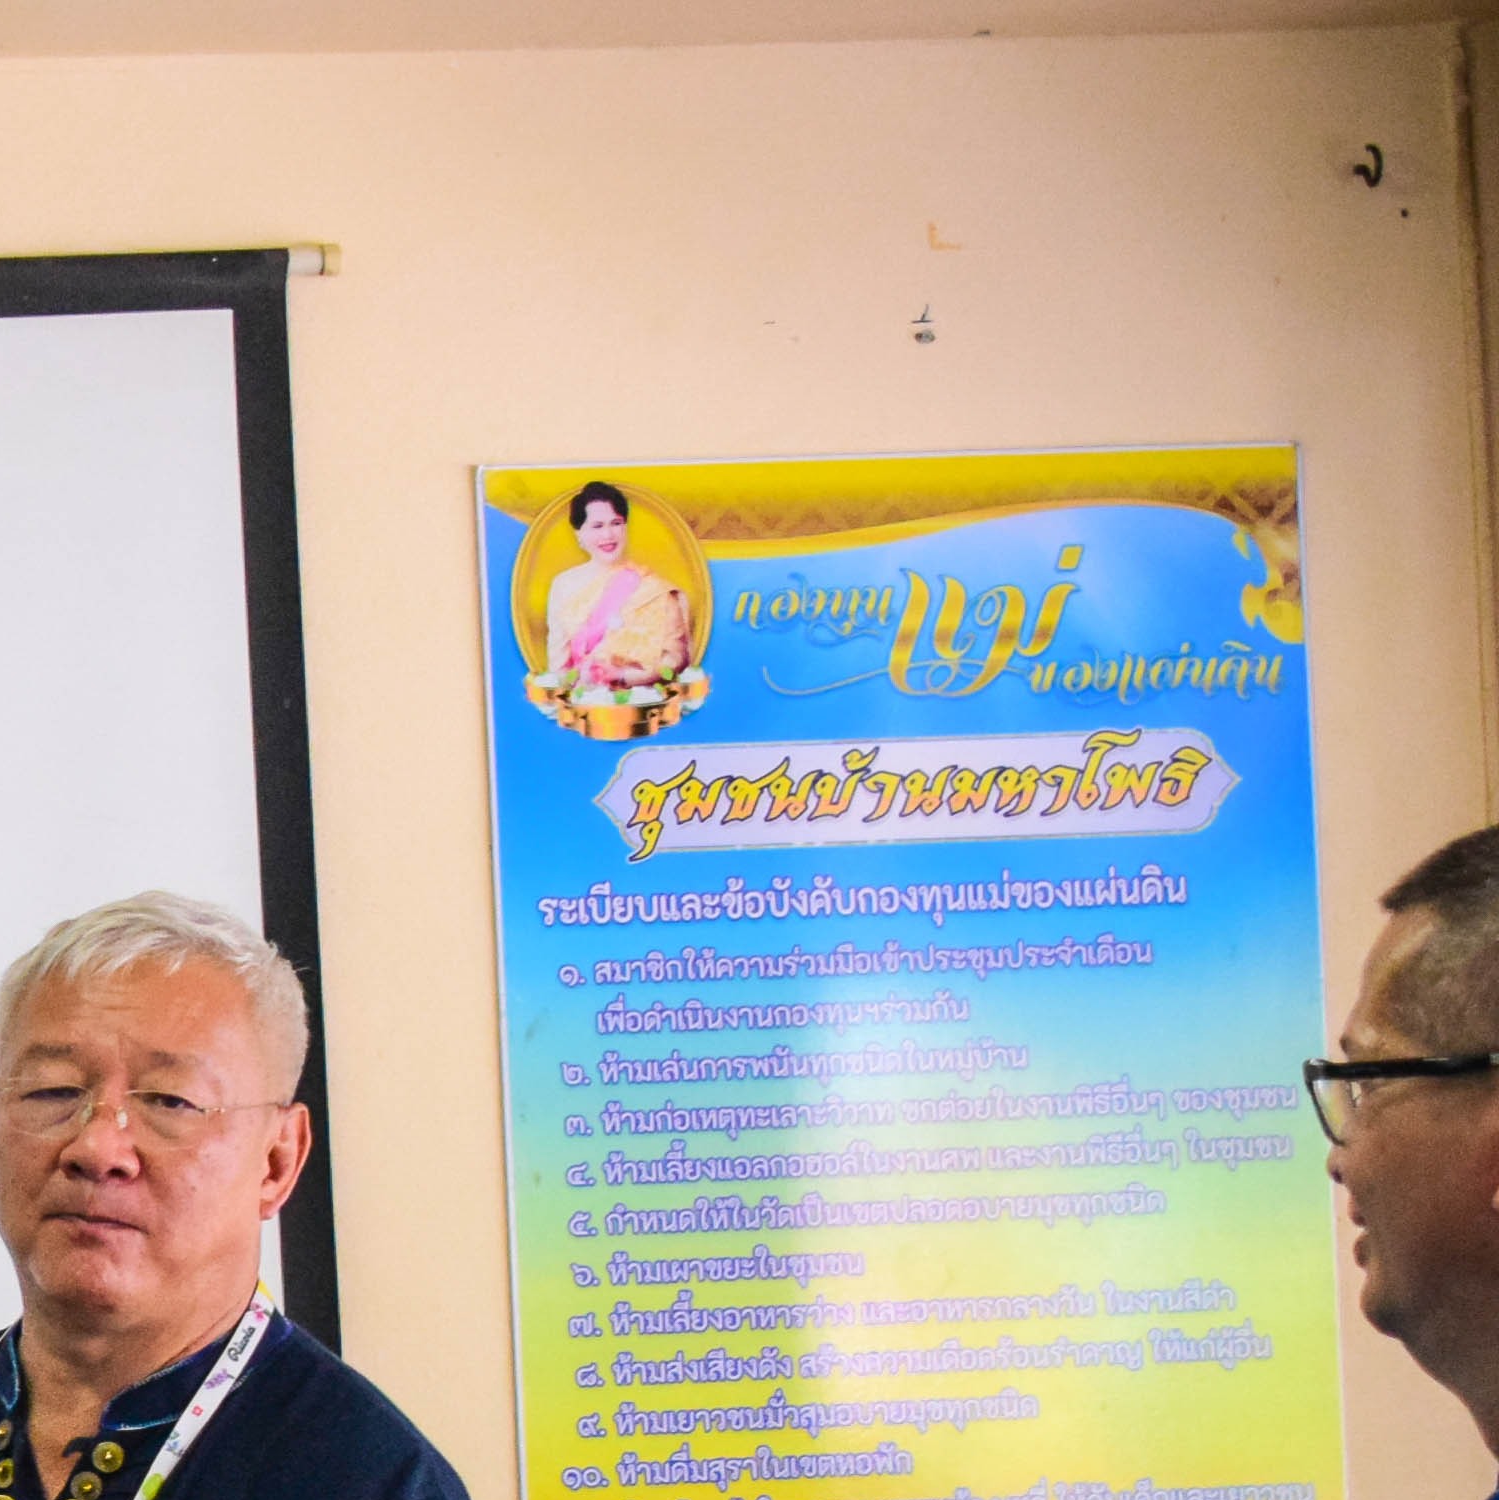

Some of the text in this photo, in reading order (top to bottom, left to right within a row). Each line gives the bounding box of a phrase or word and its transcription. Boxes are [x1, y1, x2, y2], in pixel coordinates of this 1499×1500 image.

[885, 544, 1085, 697] แม่
[628, 725, 1213, 862] ชุมชนบ้านมหาโพธิ
[537, 863, 1187, 927] ระเบียบและข้อบังคับกองทุนแม่ของแผ่นดิน
[559, 932, 1152, 986] ๑. สมาชิกให้ความร่วมมือเข้าประชุมประจำเดือน
[597, 990, 969, 1036] เพื่อดำเนินงานกองทุนฯร่วมกัน
[599, 1036, 1028, 1085] ห้ามเล่นการพนันทุกชนิดในหมู่บ้าน
[601, 1095, 893, 1140] ห้ามก่อเหตุทะเลาะวิวาท
[1173, 1086, 1298, 1123] ของชุมชน
[603, 1139, 980, 1184] ห้ามเลี้ยงแอลกอฮอล์ในงานศพ
[1184, 1126, 1293, 1171] ในชุมชน
[607, 1244, 864, 1288] ห้ามเผาขยะในชุมชน
[609, 1289, 853, 1335] ห้ามเลี้ยงอาหารว่าง
[860, 1284, 1095, 1325] และอาหารกลางวัน
[612, 1347, 793, 1385] ห้ามส่งเสียงดัง
[799, 1335, 1143, 1378] สร้างความเดือดร้อนรำคาญ
[613, 1386, 1039, 1437] ห้ามเยาวชนมั่วสุมอบายมุขทุกชนิด
[617, 1441, 913, 1492] ห้ามดื่มสุราในเขตหอพัก
